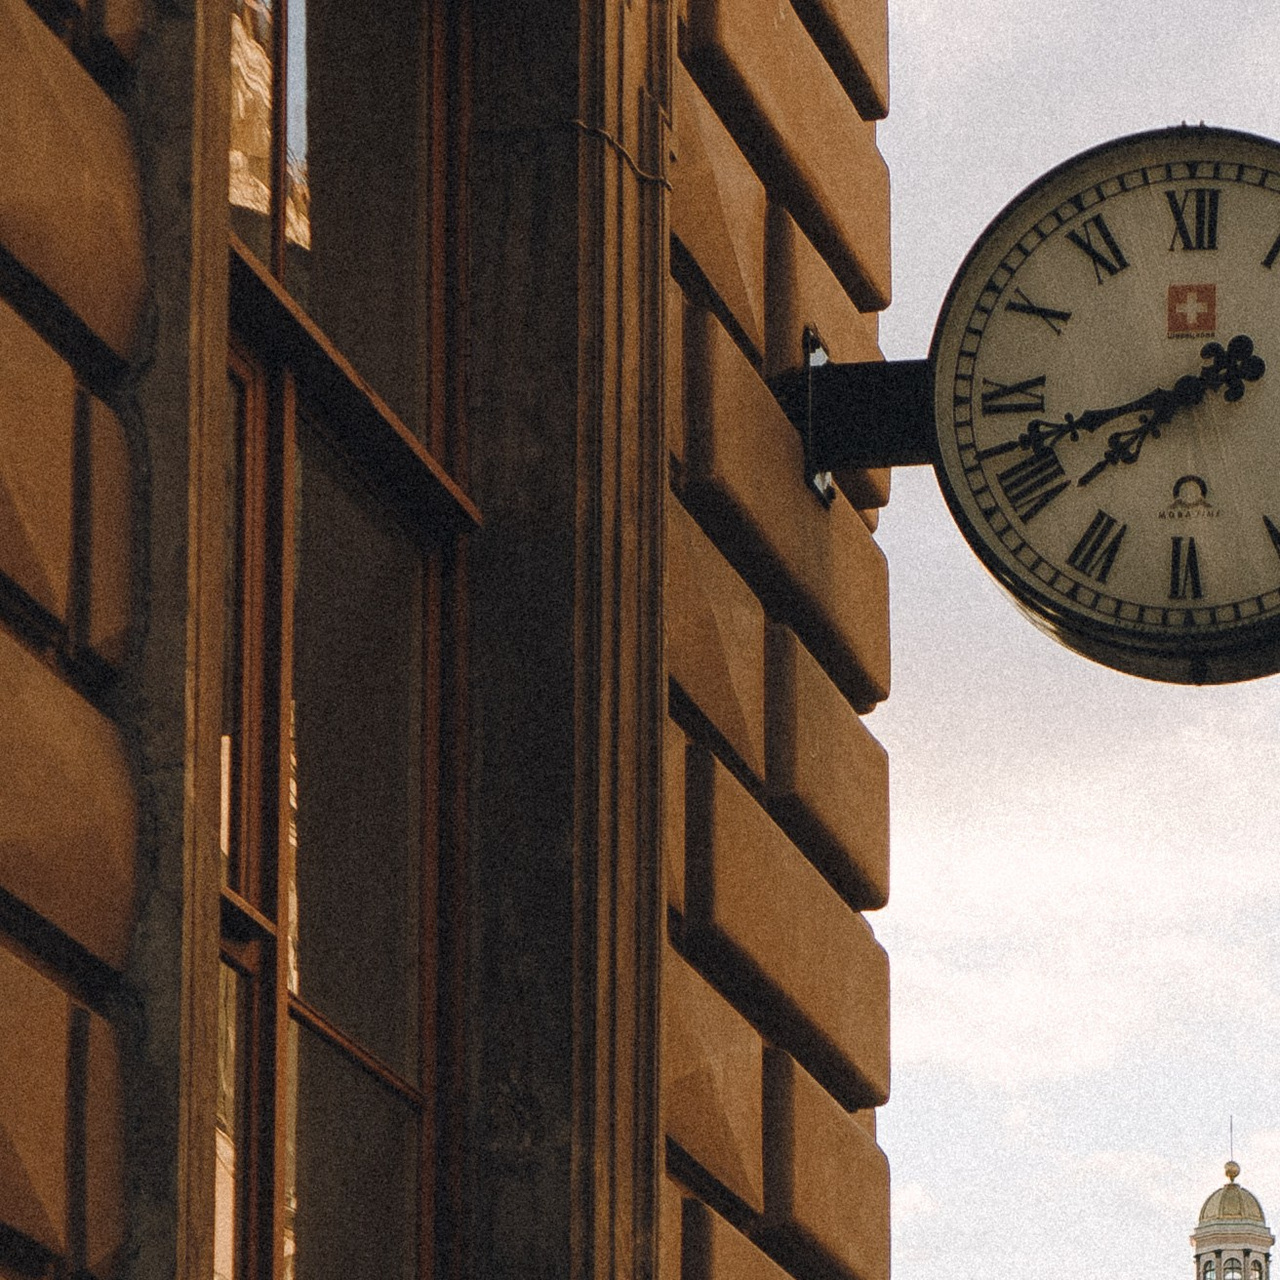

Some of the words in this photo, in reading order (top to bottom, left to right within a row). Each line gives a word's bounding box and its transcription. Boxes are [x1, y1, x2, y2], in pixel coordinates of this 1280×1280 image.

[1066, 211, 1131, 284] XI
[1166, 188, 1220, 250] XII
[1005, 287, 1072, 336] X
[981, 375, 1047, 415] IX
[1067, 509, 1127, 584] VII
[1168, 536, 1203, 600] VI
